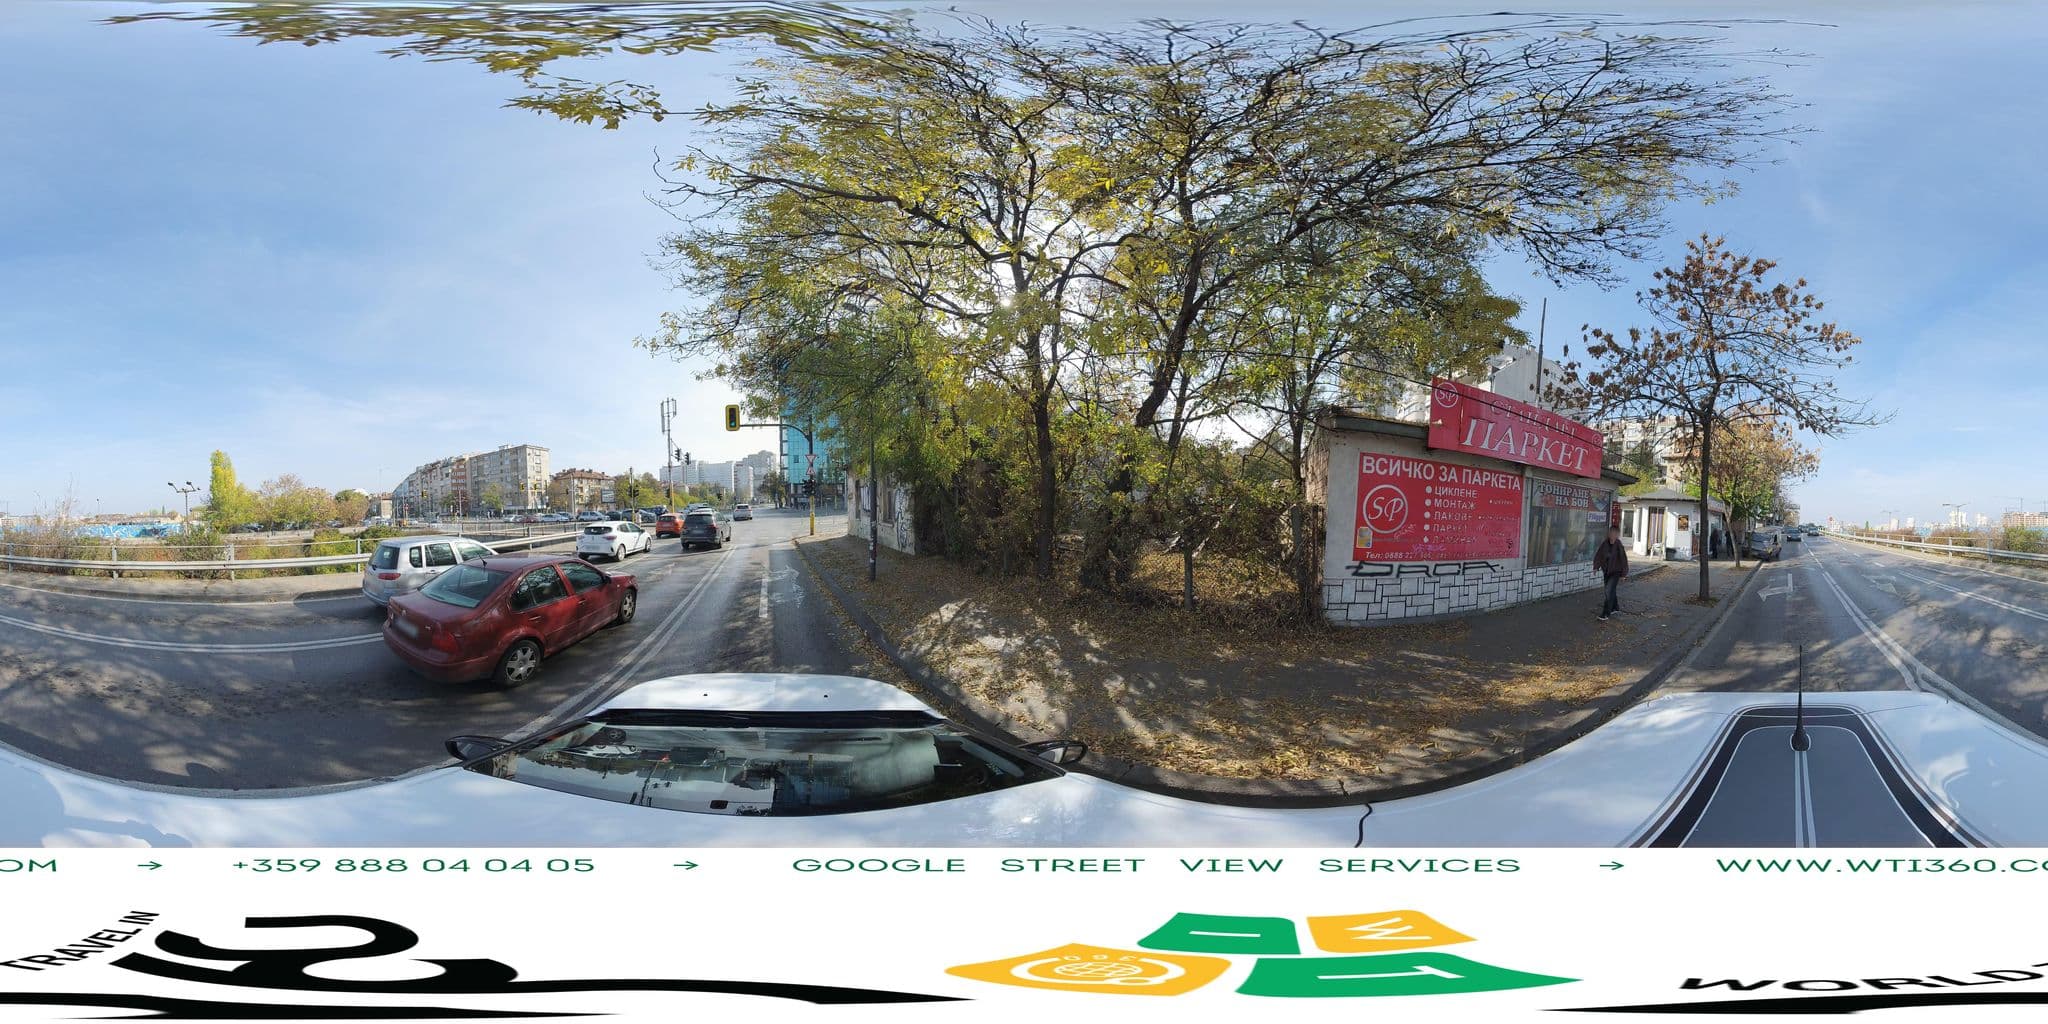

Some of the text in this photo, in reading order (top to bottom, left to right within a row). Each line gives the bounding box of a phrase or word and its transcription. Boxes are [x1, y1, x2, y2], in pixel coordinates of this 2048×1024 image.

[1461, 418, 1589, 470] ПАРКЕТ
[1362, 456, 1521, 490] ВСИЧКО ЗА ПАРКЕТА
[1434, 485, 1478, 498] ЦИКЛЕНЕ
[1555, 496, 1569, 506] НА
[1368, 497, 1404, 522] SP
[1434, 498, 1476, 510] МОНТАЖ
